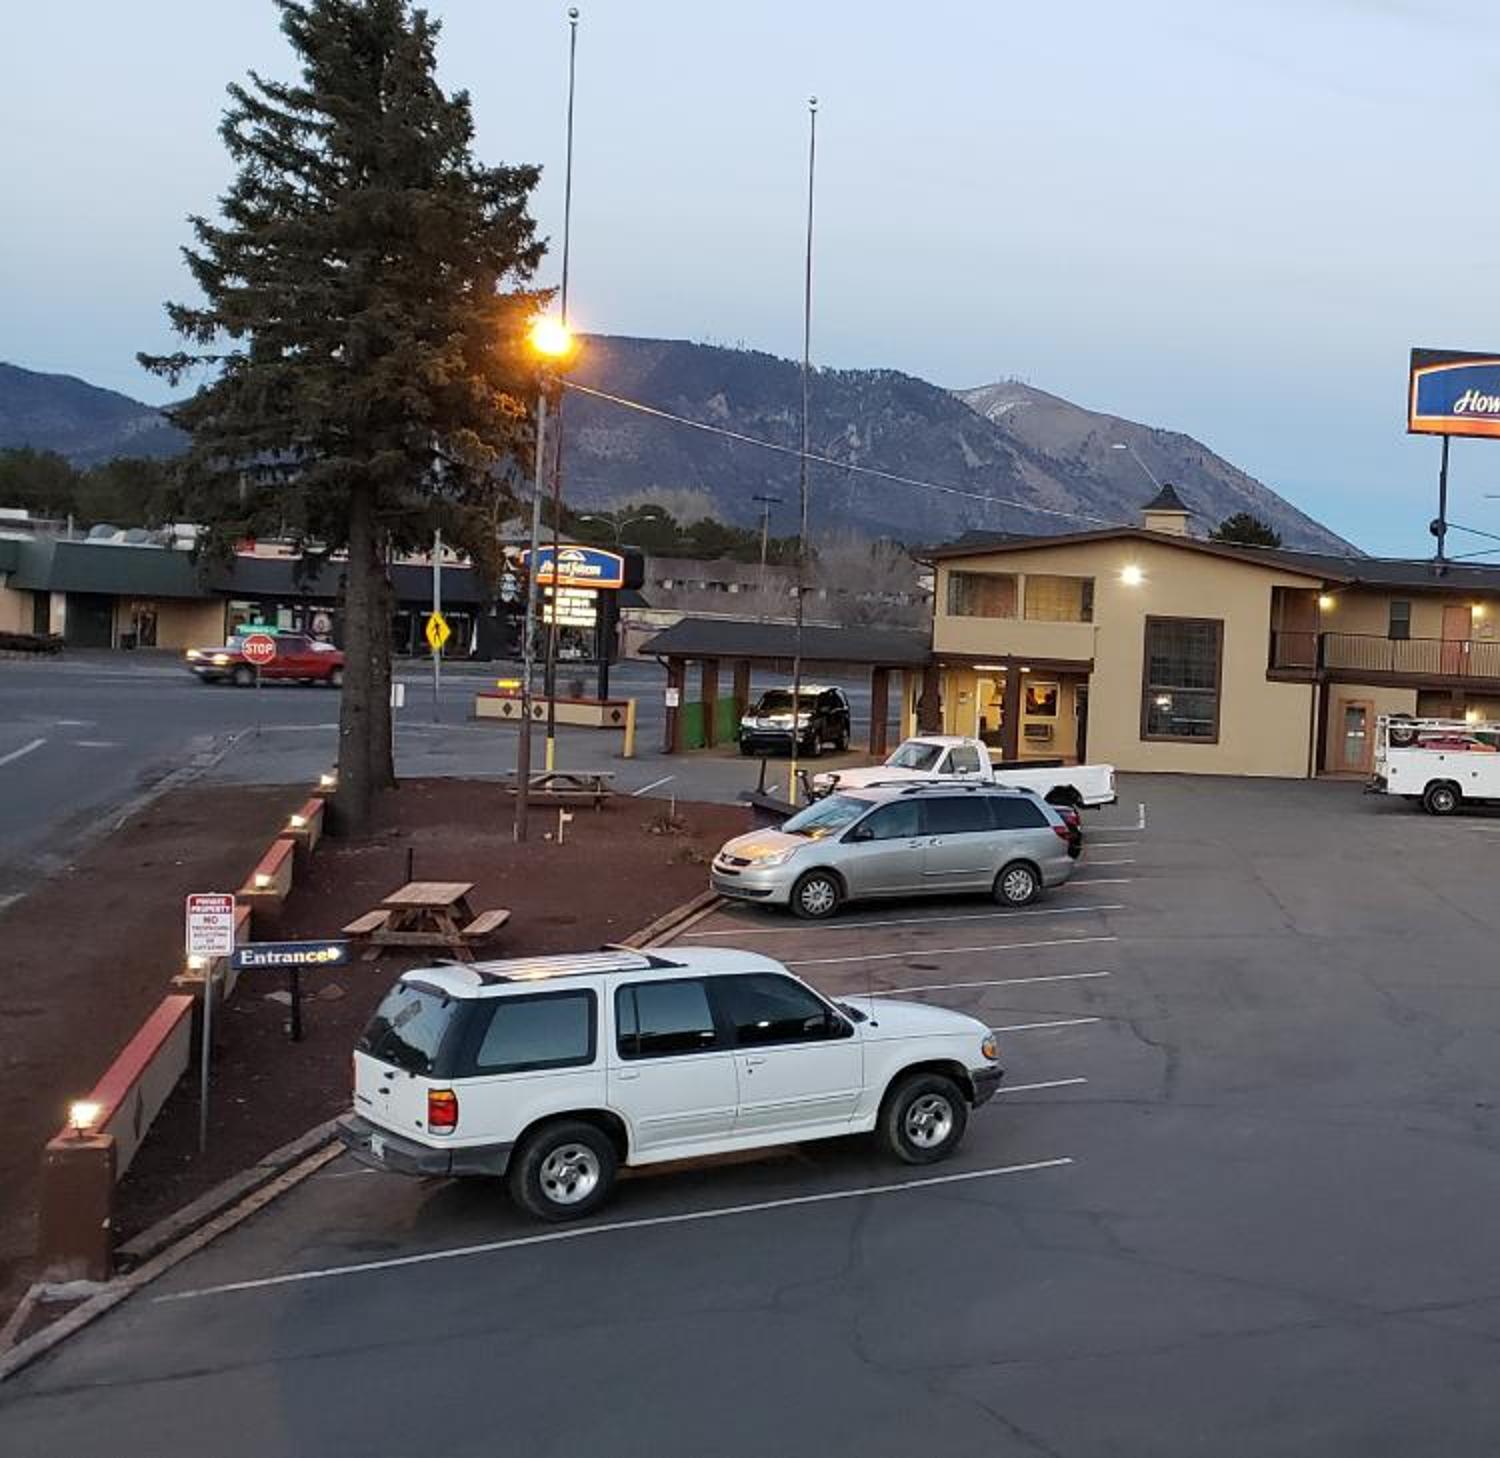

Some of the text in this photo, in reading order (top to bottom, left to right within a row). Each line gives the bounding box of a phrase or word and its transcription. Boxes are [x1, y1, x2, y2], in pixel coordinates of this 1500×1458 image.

[245, 643, 273, 655] STOP
[203, 915, 219, 924] NO
[240, 950, 328, 965] Entrance
